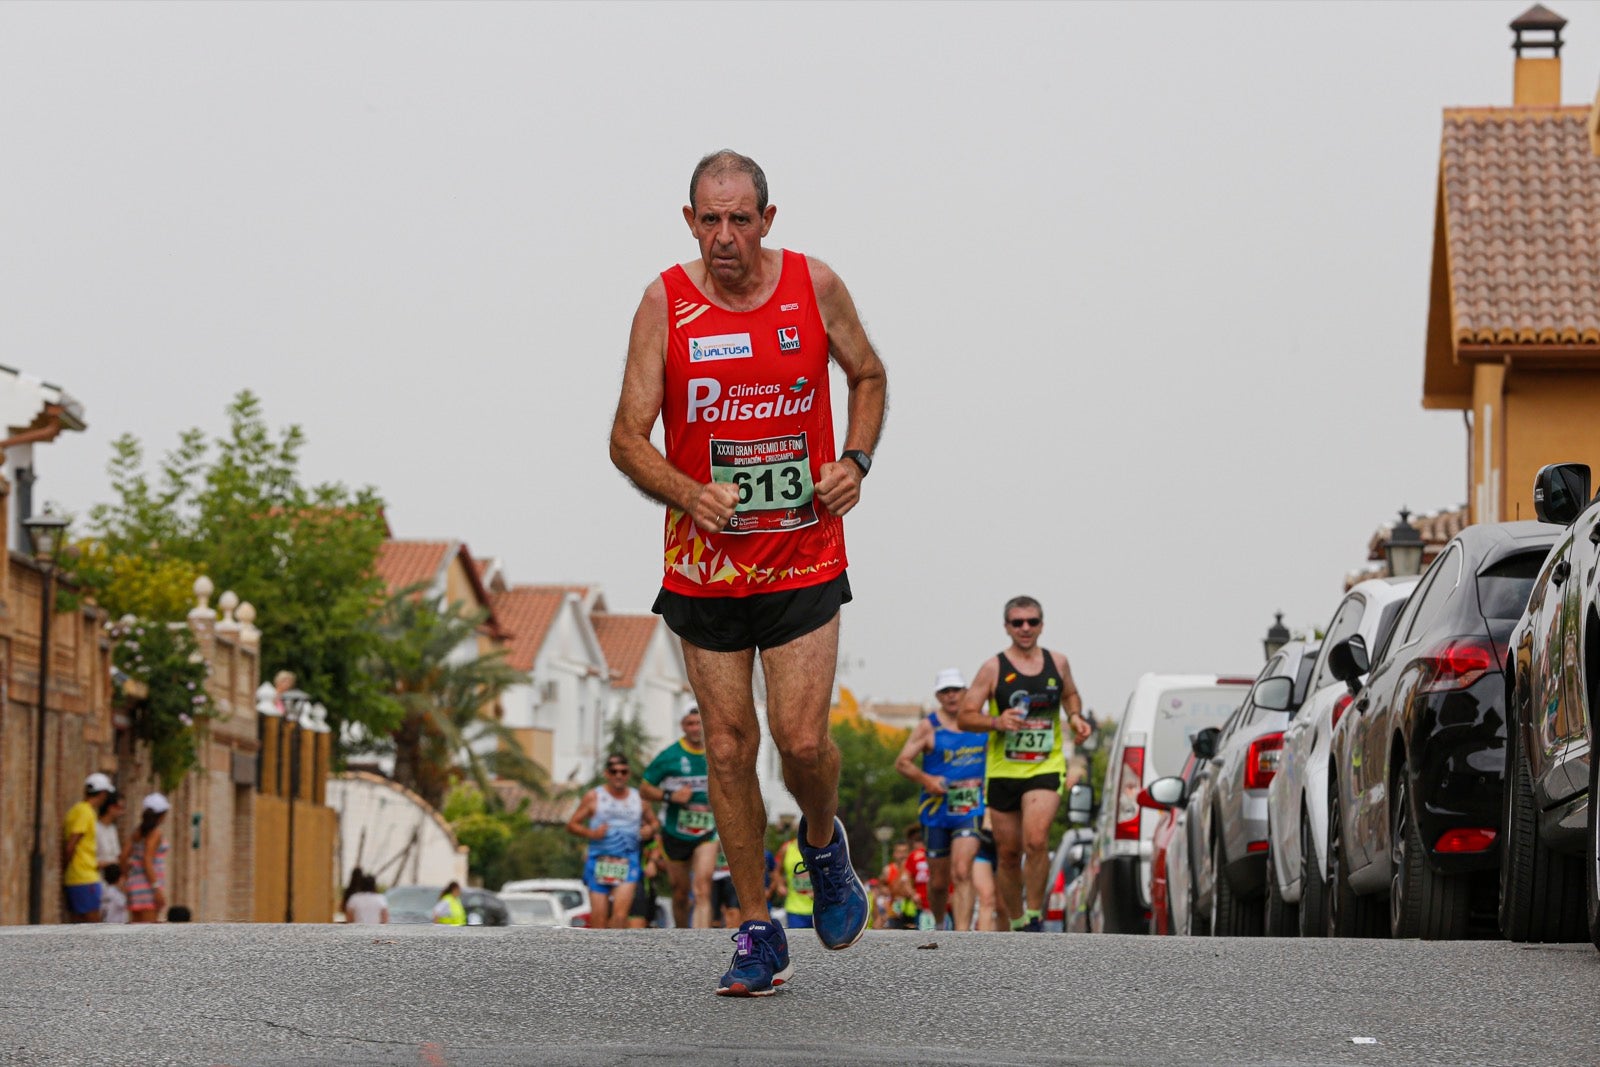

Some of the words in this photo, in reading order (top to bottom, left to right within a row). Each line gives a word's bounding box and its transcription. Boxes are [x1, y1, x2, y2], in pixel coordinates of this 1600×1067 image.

[780, 340, 800, 350] MOVE
[728, 383, 781, 397] Clínicas
[686, 377, 816, 424] Polisalud
[716, 444, 735, 456] XXXII
[735, 444, 753, 456] GRAN
[753, 442, 779, 455] PREMIO
[779, 440, 788, 452] DE
[734, 455, 762, 465] DIPUTACIÓN
[765, 452, 794, 463] CRUZCAMPO
[732, 466, 803, 505] 613
[1015, 732, 1046, 748] 737
